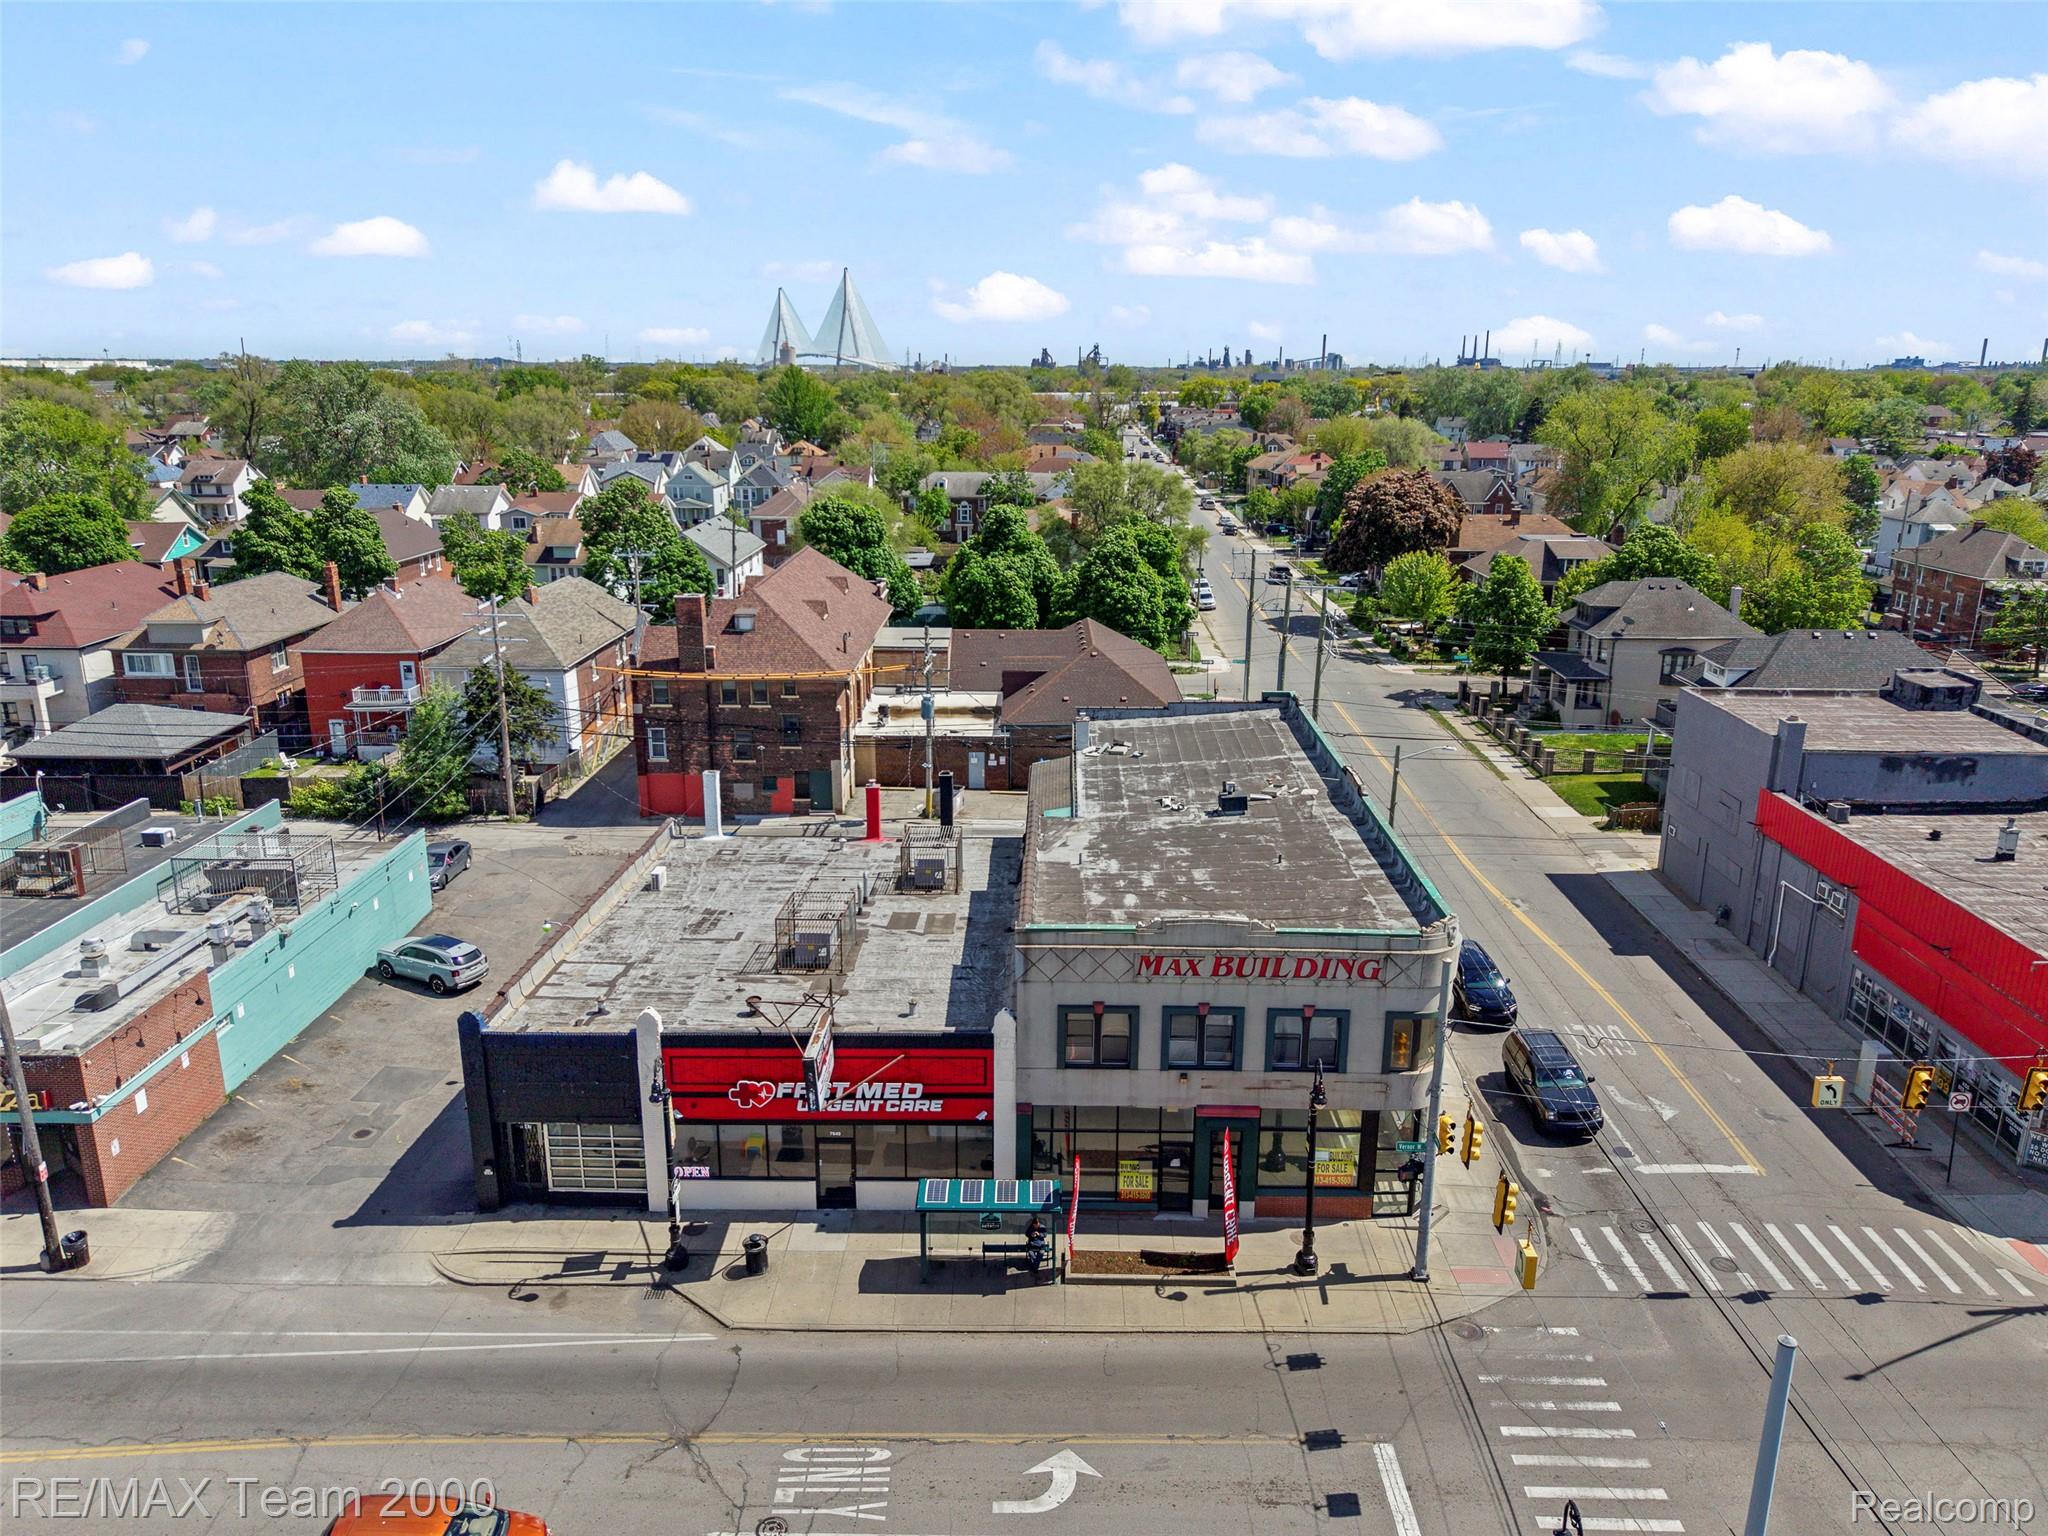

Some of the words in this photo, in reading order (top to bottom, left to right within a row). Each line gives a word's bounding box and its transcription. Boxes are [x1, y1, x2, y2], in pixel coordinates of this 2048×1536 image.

[1137, 955, 1204, 977] MAX
[1211, 956, 1383, 980] BUILDING
[856, 1082, 923, 1099] MED
[886, 1100, 943, 1112] CARE
[674, 1166, 711, 1177] OPEN
[1317, 1163, 1330, 1173] FOR
[1332, 1163, 1348, 1173] SALE
[1123, 1175, 1134, 1188] FOR
[1135, 1175, 1149, 1188] SALE
[771, 1447, 892, 1521] ONLY
